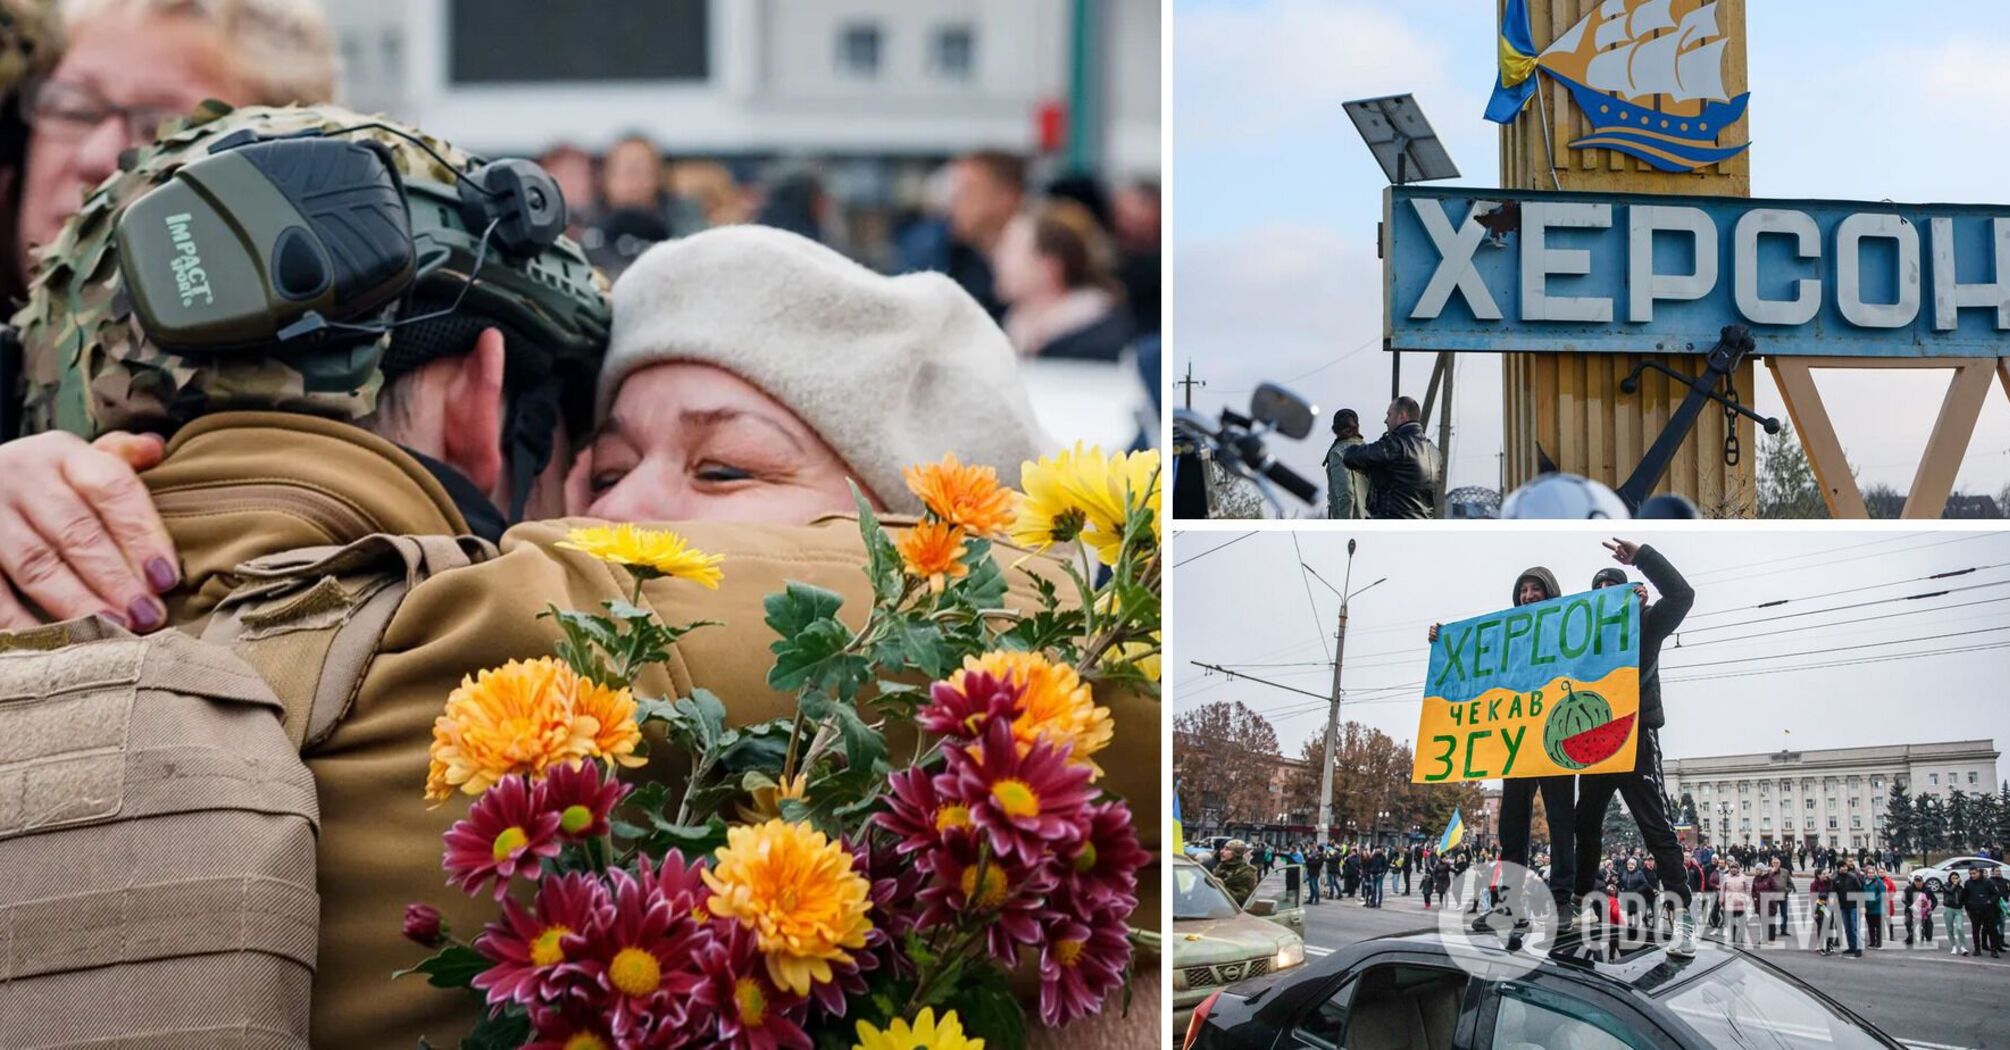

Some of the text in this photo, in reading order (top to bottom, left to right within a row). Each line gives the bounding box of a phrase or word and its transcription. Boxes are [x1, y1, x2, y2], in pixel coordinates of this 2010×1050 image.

[1409, 197, 2010, 331] ХЕРСОН
[1435, 588, 1632, 687] ХЕРСОН
[1450, 691, 1543, 726] ЧЕКАВ
[1425, 726, 1526, 781] ЗСУ
